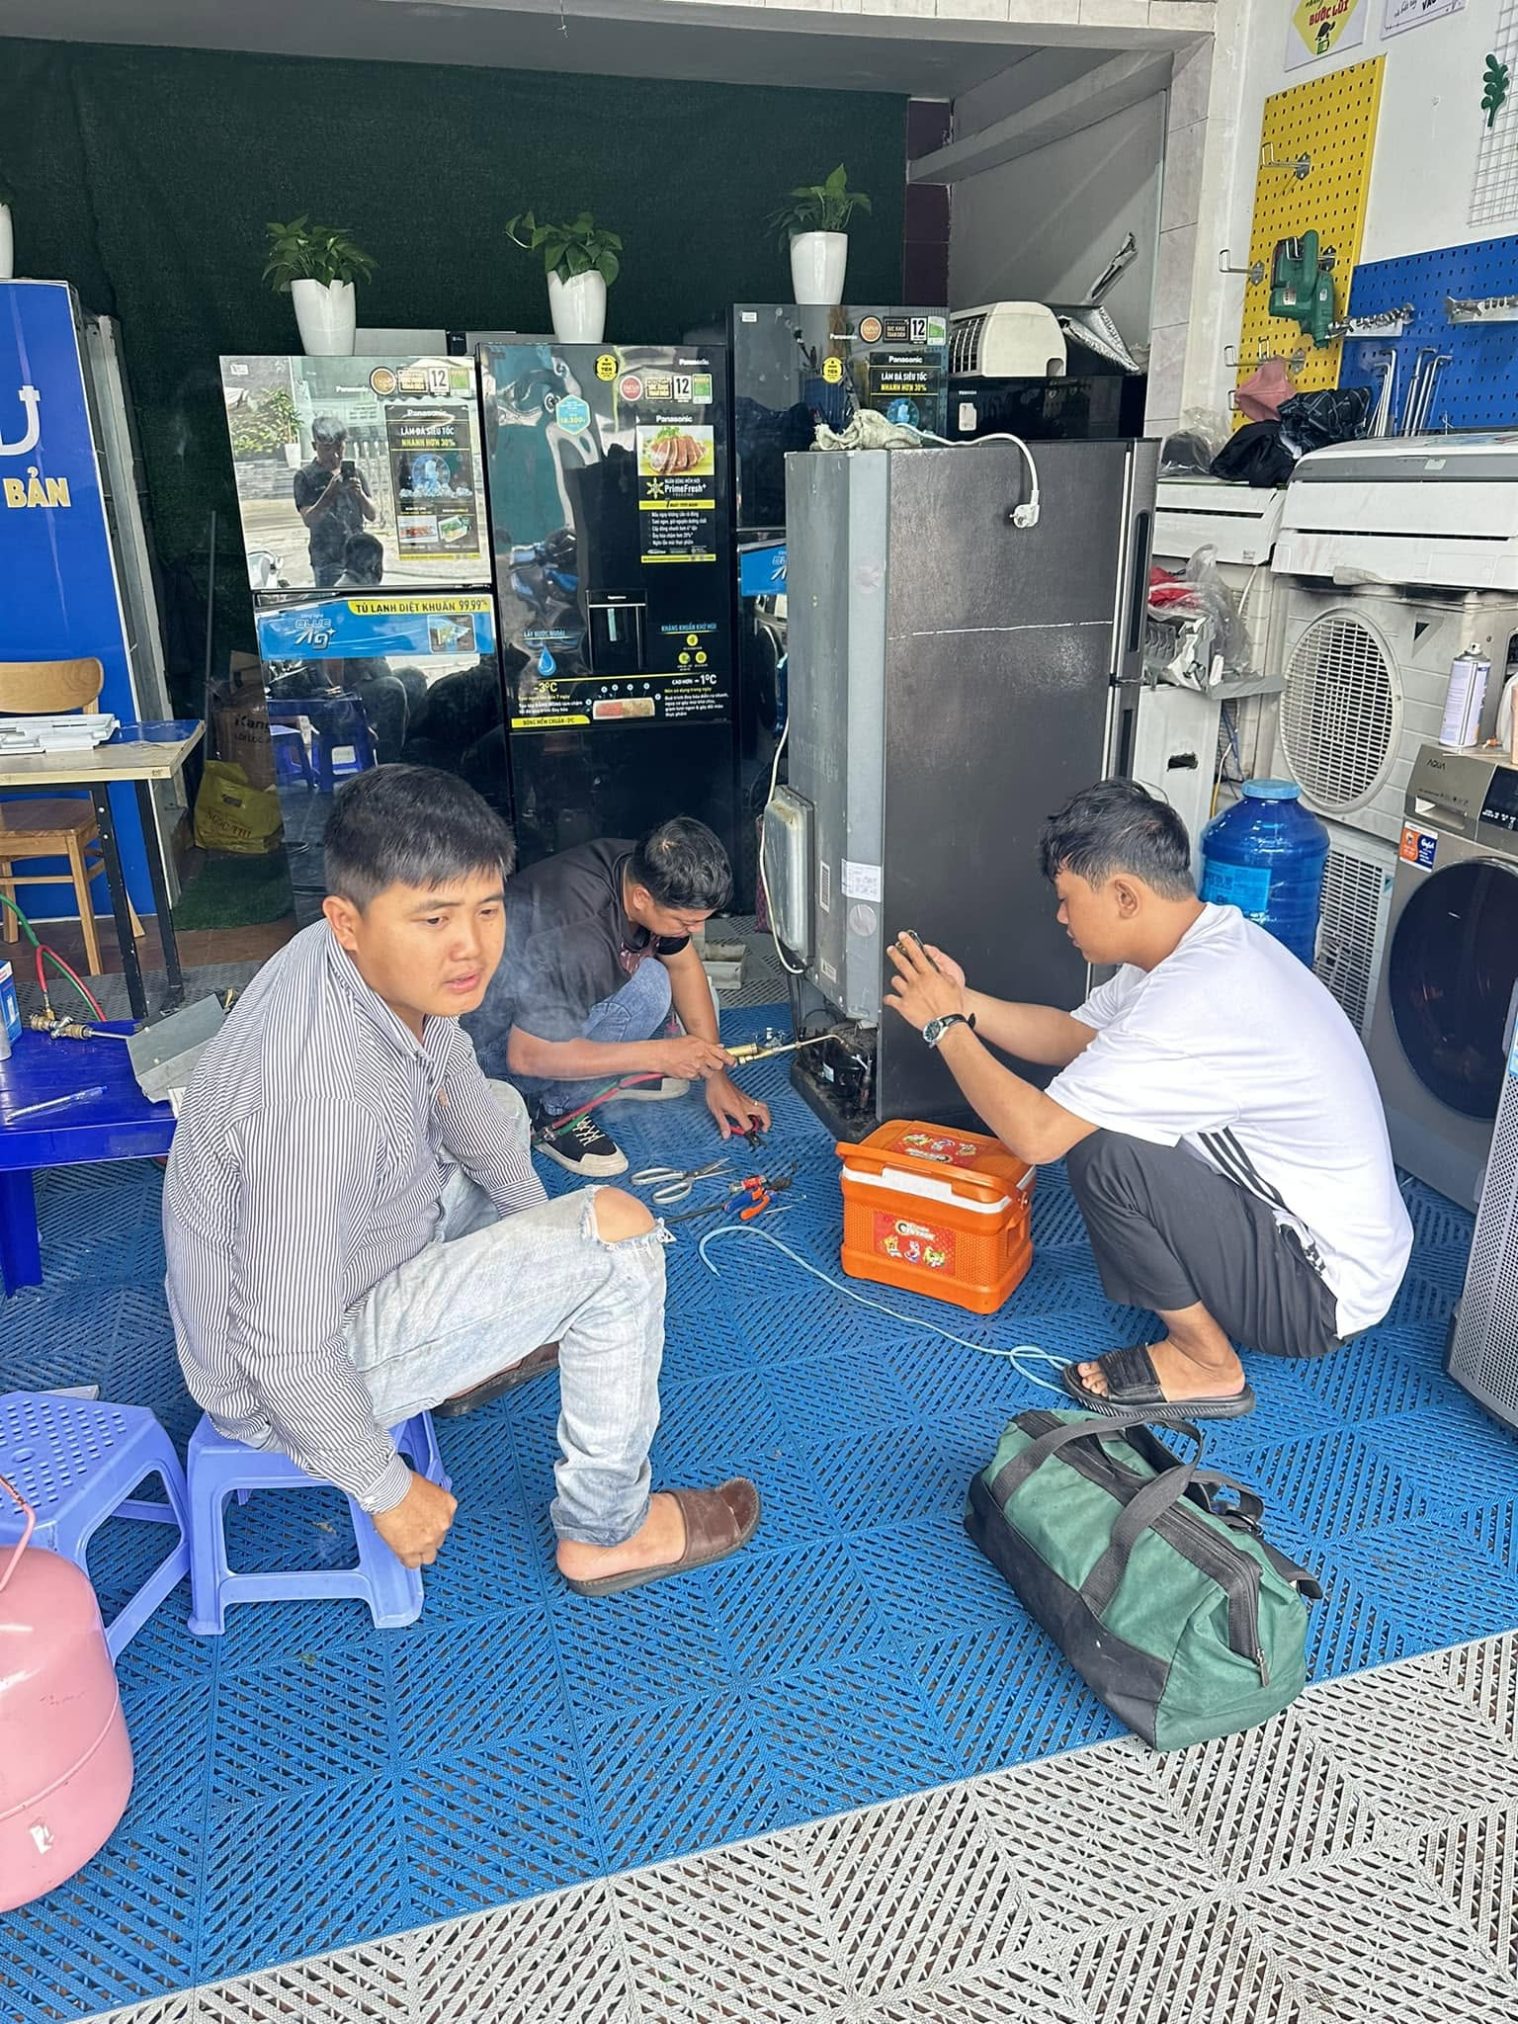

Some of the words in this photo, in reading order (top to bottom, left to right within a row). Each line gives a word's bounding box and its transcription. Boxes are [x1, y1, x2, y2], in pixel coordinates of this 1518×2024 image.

[913, 320, 925, 336] 12
[889, 355, 923, 364] Panasonic
[431, 370, 447, 388] 12
[676, 378, 690, 394] 12
[656, 415, 693, 423] Panasonic
[3, 466, 71, 508] BẢN
[356, 602, 368, 613] TỦ
[371, 602, 397, 614] LẠNH
[400, 601, 420, 612] DIỆT
[422, 601, 456, 611] KHUẨN
[1427, 758, 1446, 770] AQUA
